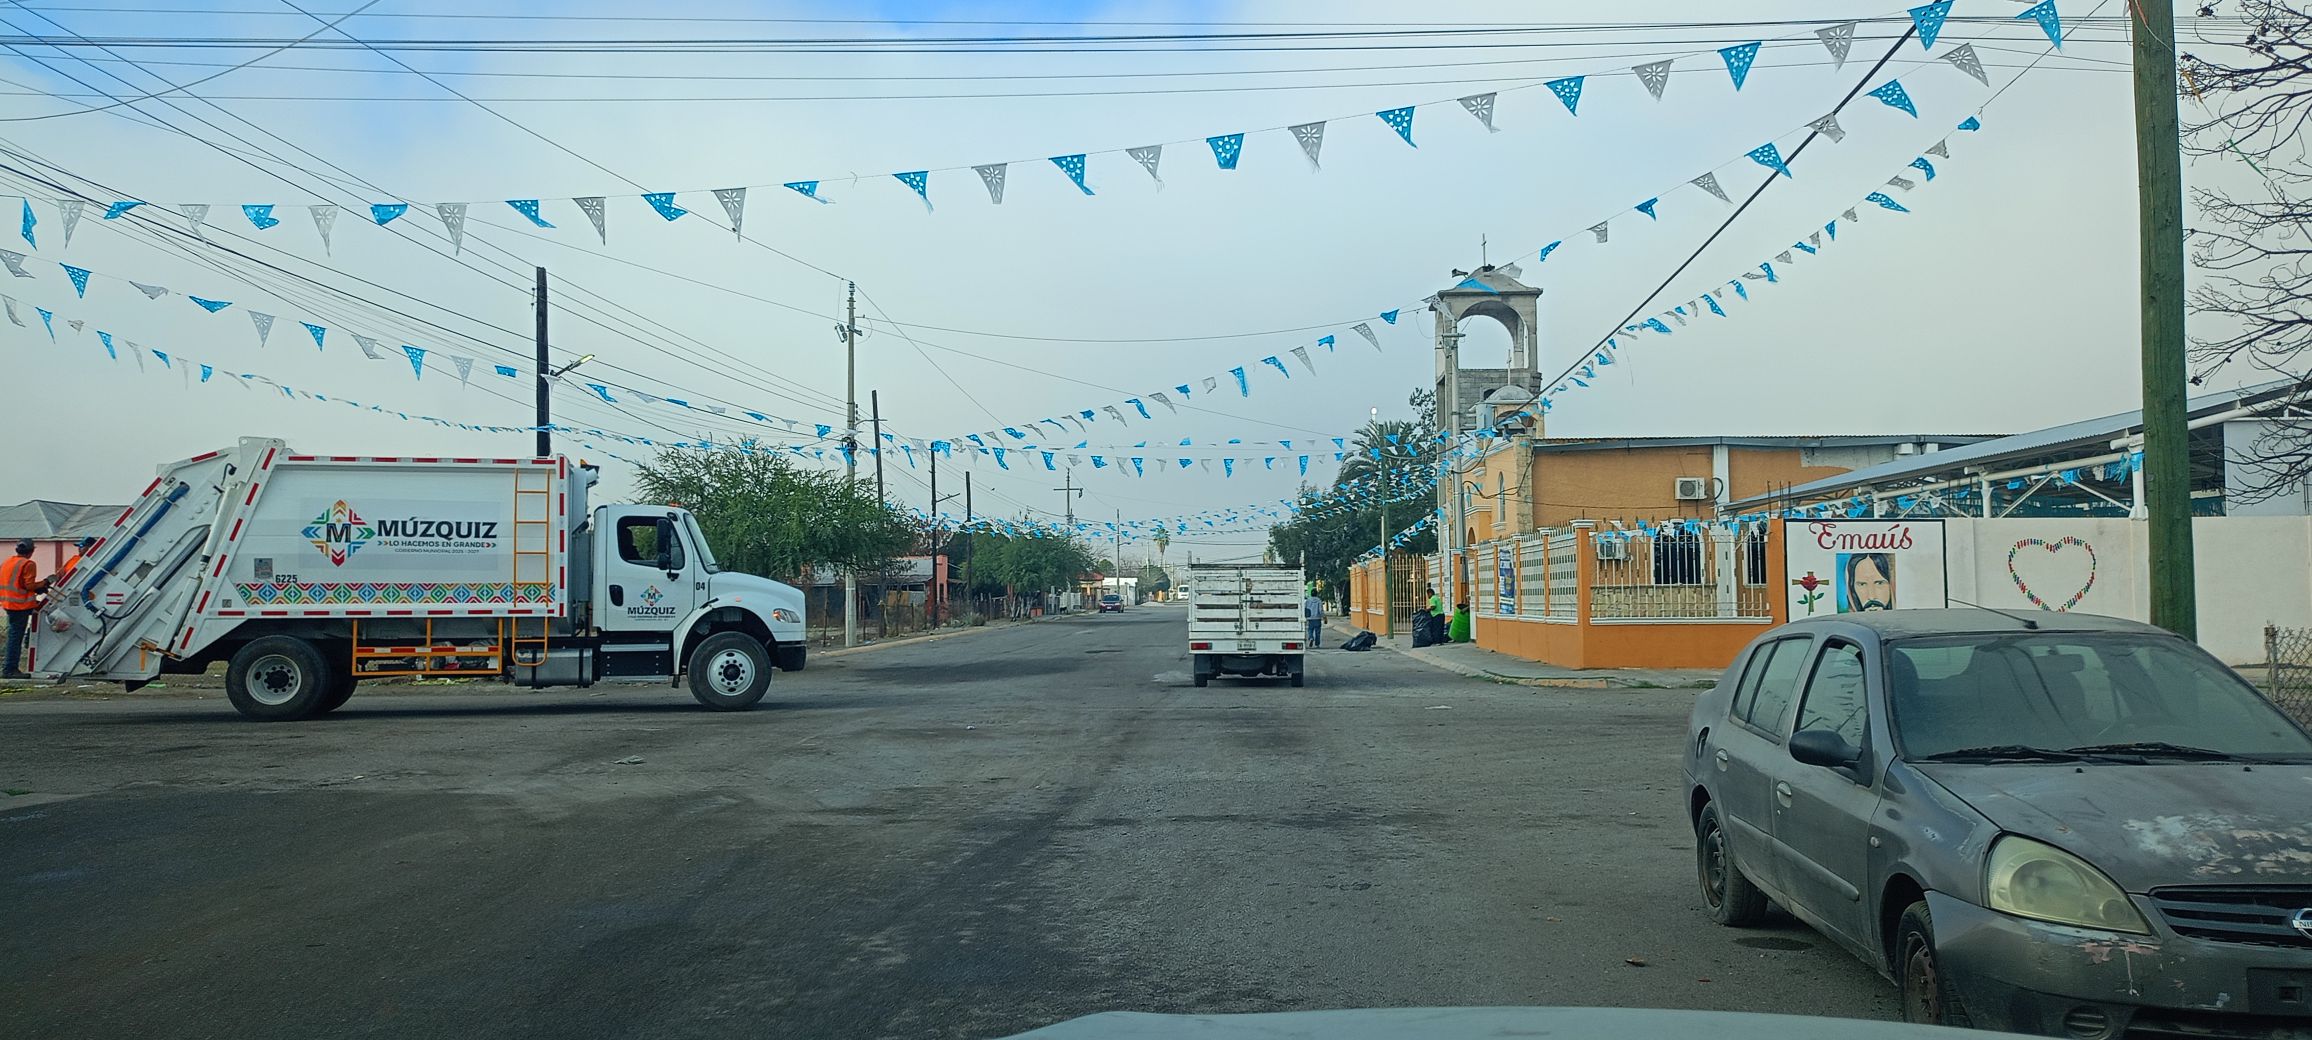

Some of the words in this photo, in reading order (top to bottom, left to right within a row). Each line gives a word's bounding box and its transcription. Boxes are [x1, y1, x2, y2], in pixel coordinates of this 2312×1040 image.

[377, 516, 498, 540] MÚZQUIZ
[326, 523, 352, 543] M
[1808, 522, 1912, 549] Emaús
[401, 540, 440, 548] HACEMOS
[275, 574, 298, 583] 6225
[696, 582, 705, 591] 04
[627, 606, 676, 615] MÚZQUIZ
